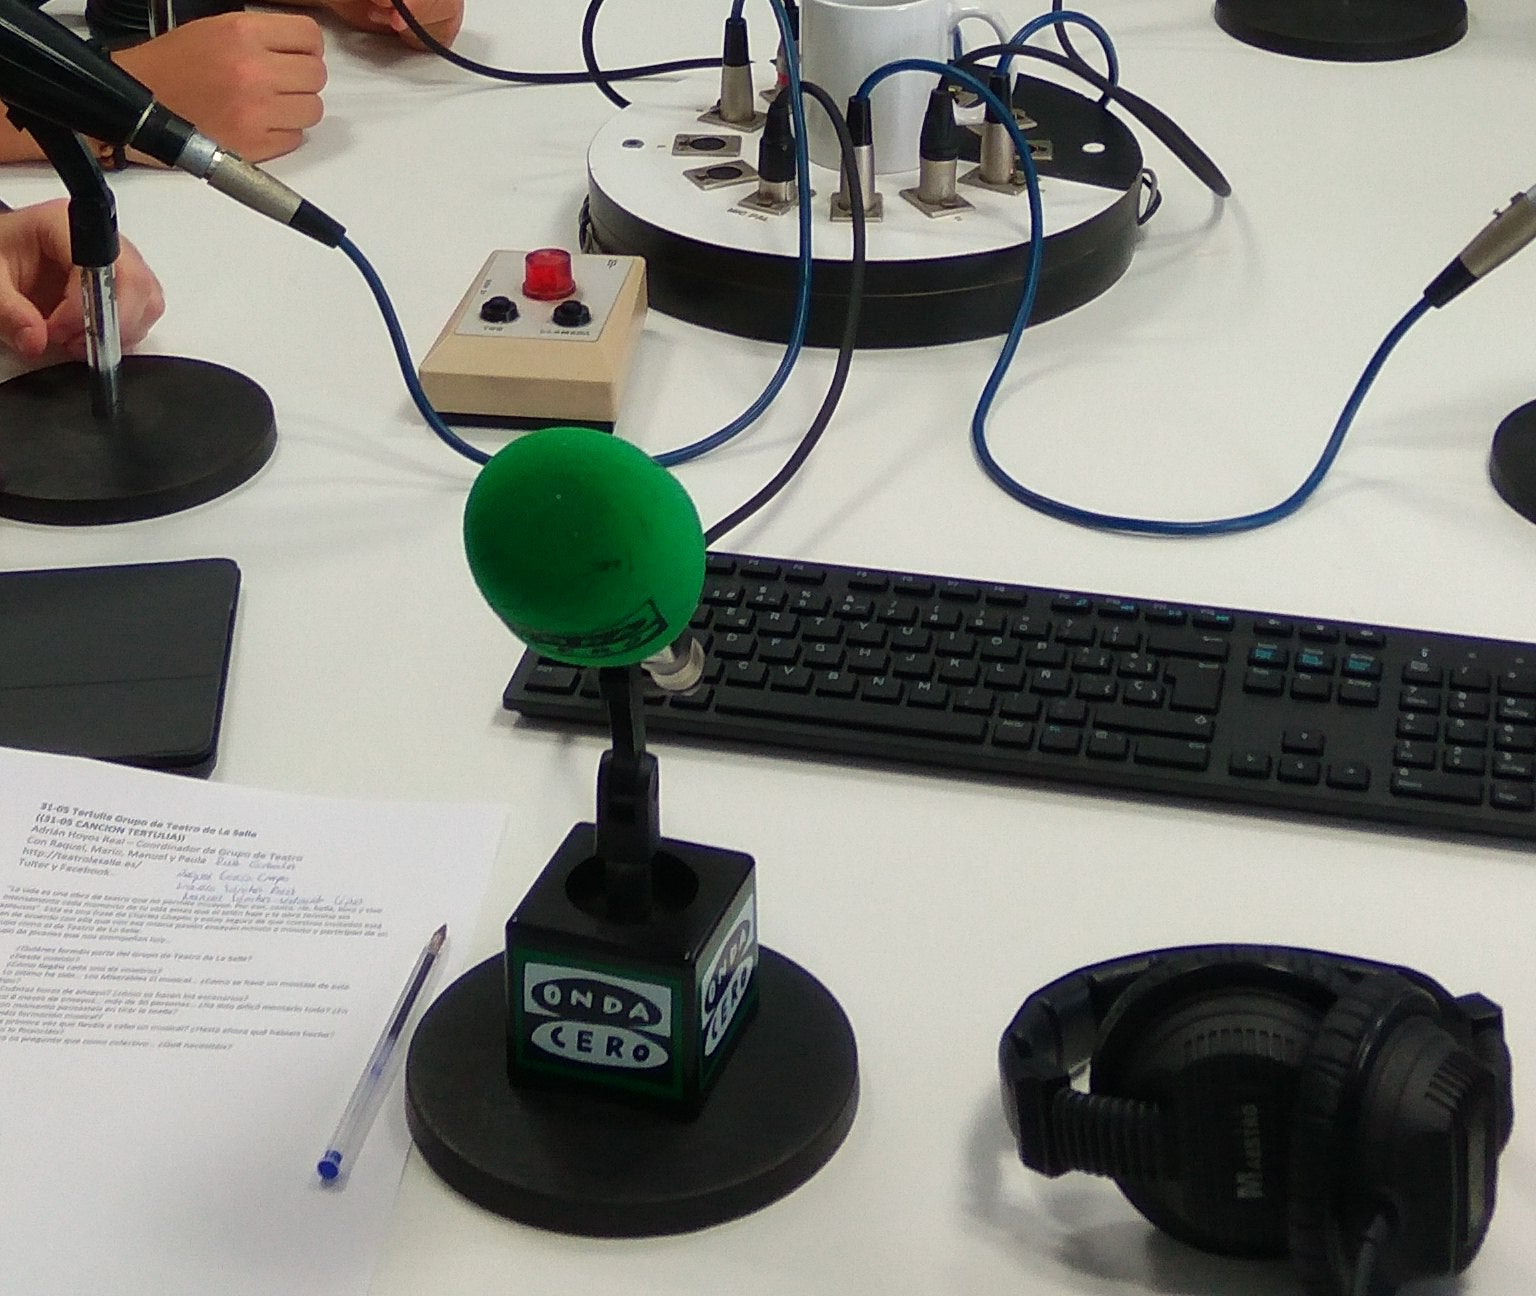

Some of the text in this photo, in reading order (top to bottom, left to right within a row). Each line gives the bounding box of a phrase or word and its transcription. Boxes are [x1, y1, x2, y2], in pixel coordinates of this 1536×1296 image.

[114, 814, 147, 826] Grupo
[150, 819, 163, 828] de
[166, 821, 200, 833] Teatro
[202, 826, 215, 834] de
[135, 840, 200, 853] Coordinador
[253, 851, 265, 859] de
[708, 928, 749, 1004] ONDA
[543, 983, 651, 1022] ONDA
[709, 963, 752, 1041] CERO
[550, 1025, 651, 1063] CERO
